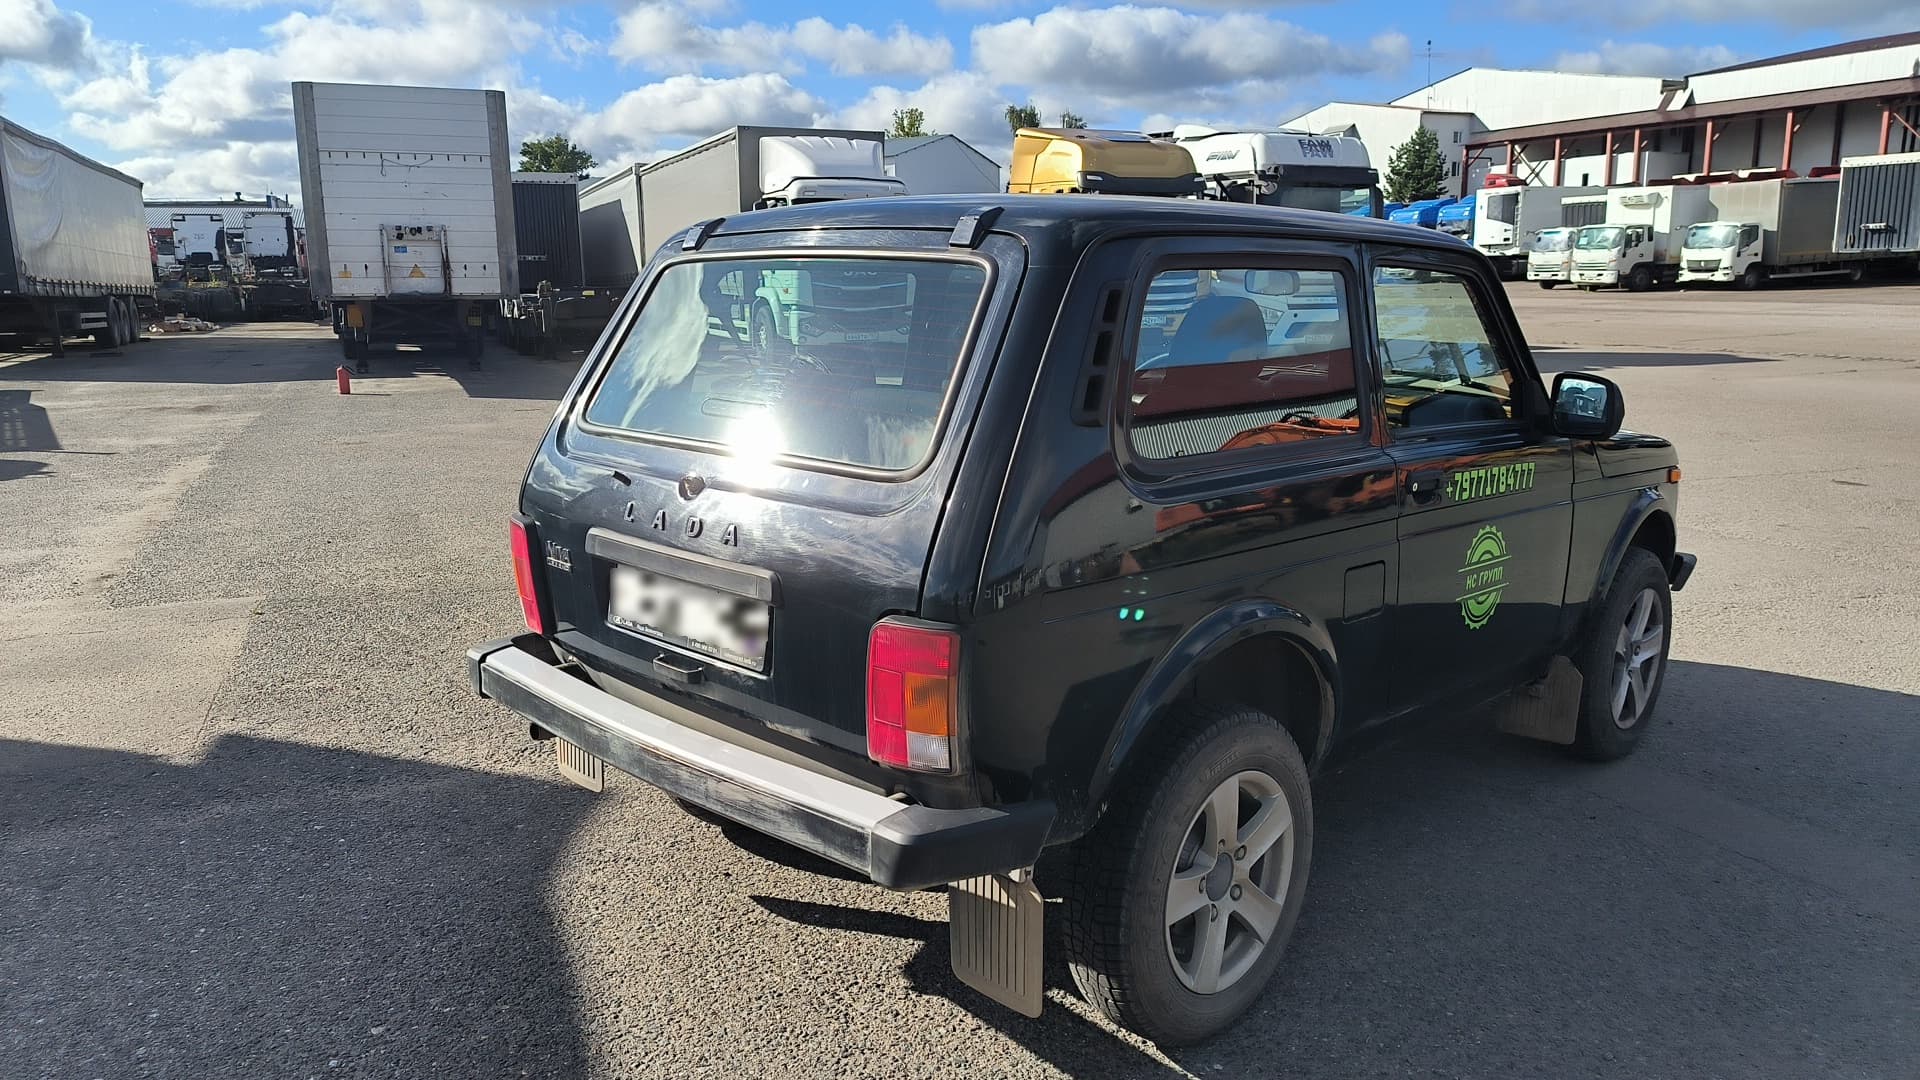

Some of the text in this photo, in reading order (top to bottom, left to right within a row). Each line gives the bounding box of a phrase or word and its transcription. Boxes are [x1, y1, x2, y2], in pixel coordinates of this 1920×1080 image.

[1298, 139, 1333, 156] FAW
[1446, 462, 1536, 501] +79771784777
[624, 501, 738, 547] LADA
[1479, 567, 1504, 586] ГРУПП
